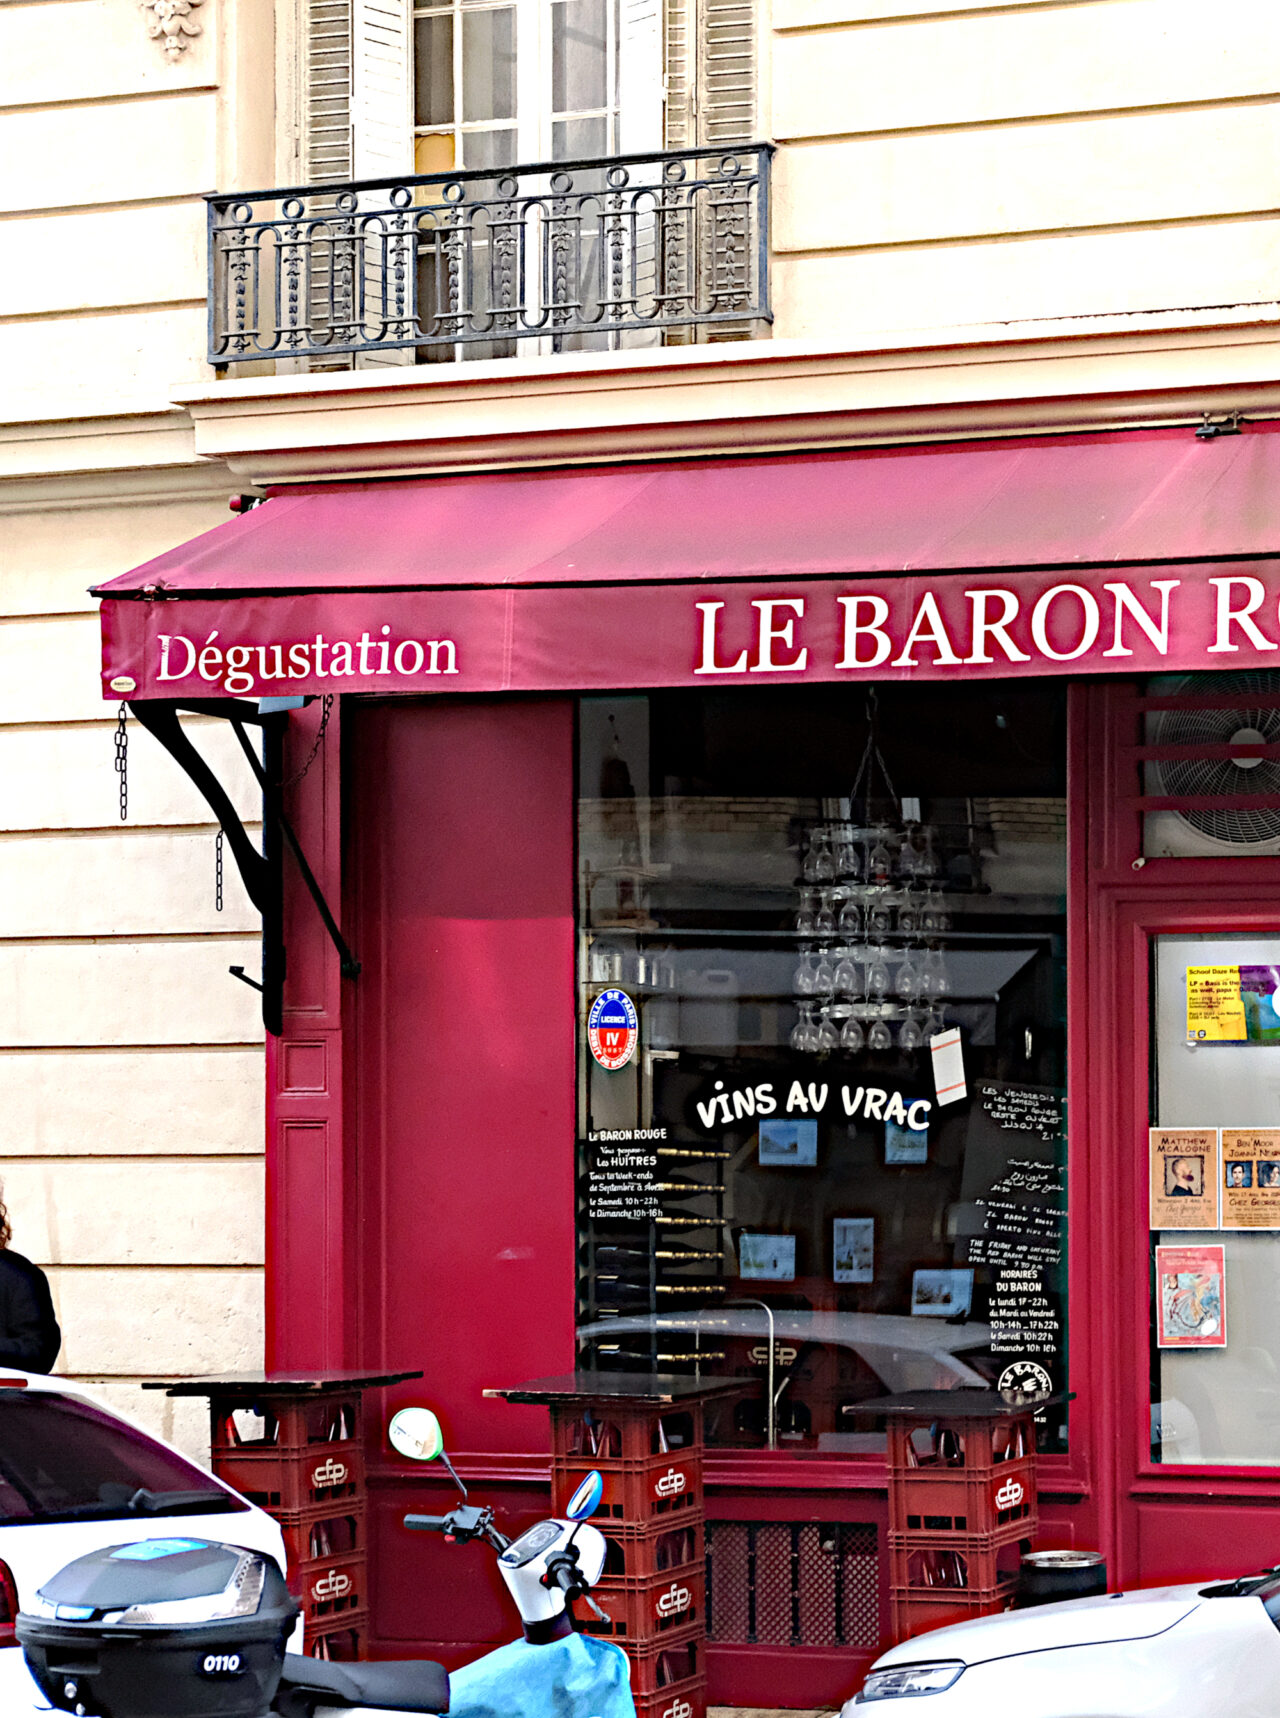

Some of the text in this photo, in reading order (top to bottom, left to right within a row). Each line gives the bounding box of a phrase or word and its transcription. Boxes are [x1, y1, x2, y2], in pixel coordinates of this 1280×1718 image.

[693, 598, 808, 675] LE
[834, 579, 1181, 669] BARON
[155, 624, 459, 694] Dégustation
[590, 991, 636, 1025] VILLE DE PARIS
[600, 1016, 626, 1024] LICENCE
[606, 1032, 620, 1046] IV
[983, 1087, 998, 1096] LES
[696, 1080, 932, 1131] VINS AU VRAC
[588, 1128, 667, 1142] Le BARON ROUGE
[1161, 1137, 1208, 1146] MATTHEW
[597, 1209, 632, 1218] Dimanche
[970, 1239, 984, 1248] THE
[988, 1241, 1012, 1250] FRIDAY
[968, 1247, 982, 1255] THE
[987, 1249, 1000, 1257] RED
[1002, 1251, 1024, 1260] BARON
[1027, 1254, 1043, 1262] WILL
[968, 1255, 986, 1263] OPEN
[988, 1258, 1007, 1266] UNTIL
[1000, 1269, 1038, 1280] HORAIRES
[995, 1282, 1042, 1293] DU BARON
[999, 1308, 1020, 1318] Mardi
[1029, 1308, 1056, 1318] Vendredi
[990, 1342, 1025, 1352] Dimanche
[1001, 1364, 1049, 1389] LE BARON
[314, 1458, 345, 1485] cfp
[658, 1468, 685, 1493] cfp
[997, 1477, 1022, 1507] cfp
[316, 1570, 349, 1598] cfp
[659, 1583, 689, 1612] cfp
[203, 1655, 240, 1672] 0110
